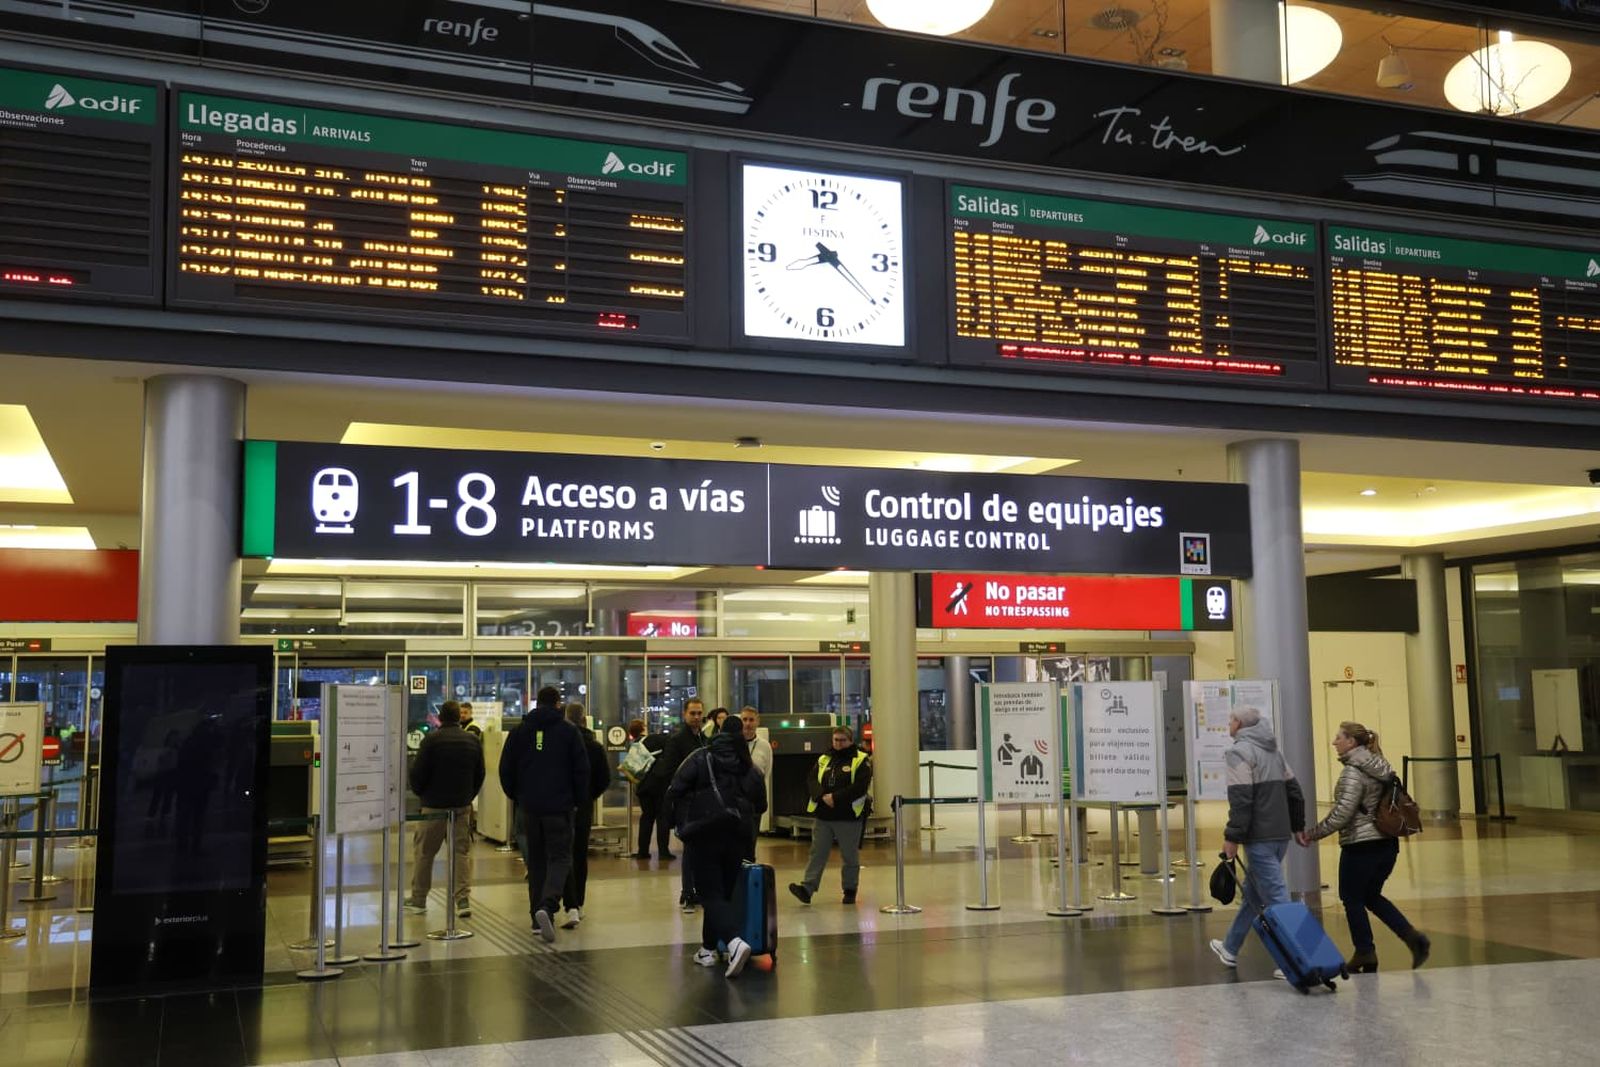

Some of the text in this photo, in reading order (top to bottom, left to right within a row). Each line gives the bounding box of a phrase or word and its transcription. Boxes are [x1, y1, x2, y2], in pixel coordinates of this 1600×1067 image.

[424, 17, 499, 46] renfe
[79, 95, 141, 114] adif
[862, 72, 1057, 148] renfe
[187, 103, 372, 142] Llegadas ARRIVALS
[1092, 106, 1246, 157] Tu tren
[181, 132, 202, 142] Hora
[236, 139, 286, 152] Procedencia
[627, 160, 677, 178] adif
[808, 188, 840, 211] 12
[957, 194, 1084, 224] Salidas DEPARTURES
[802, 226, 845, 240] FESTINA
[1271, 231, 1307, 246] adif
[757, 242, 777, 263] 9
[1333, 233, 1442, 260] Salidas DEPARTURES
[870, 253, 890, 273] 3
[816, 307, 835, 328] 6
[392, 470, 498, 538] 1-8
[521, 475, 746, 514] Acceso a vías
[865, 488, 1164, 535] Control de equipajes
[521, 517, 656, 542] PLATFORMS
[864, 527, 1052, 552] LUGGAGE CONTROL
[985, 581, 1067, 605] No pasar
[985, 605, 1071, 618] NO TRESPASSING
[671, 620, 691, 636] No
[1117, 726, 1151, 735] exclusivo
[1107, 740, 1135, 750] viajeros
[1136, 741, 1150, 749] con
